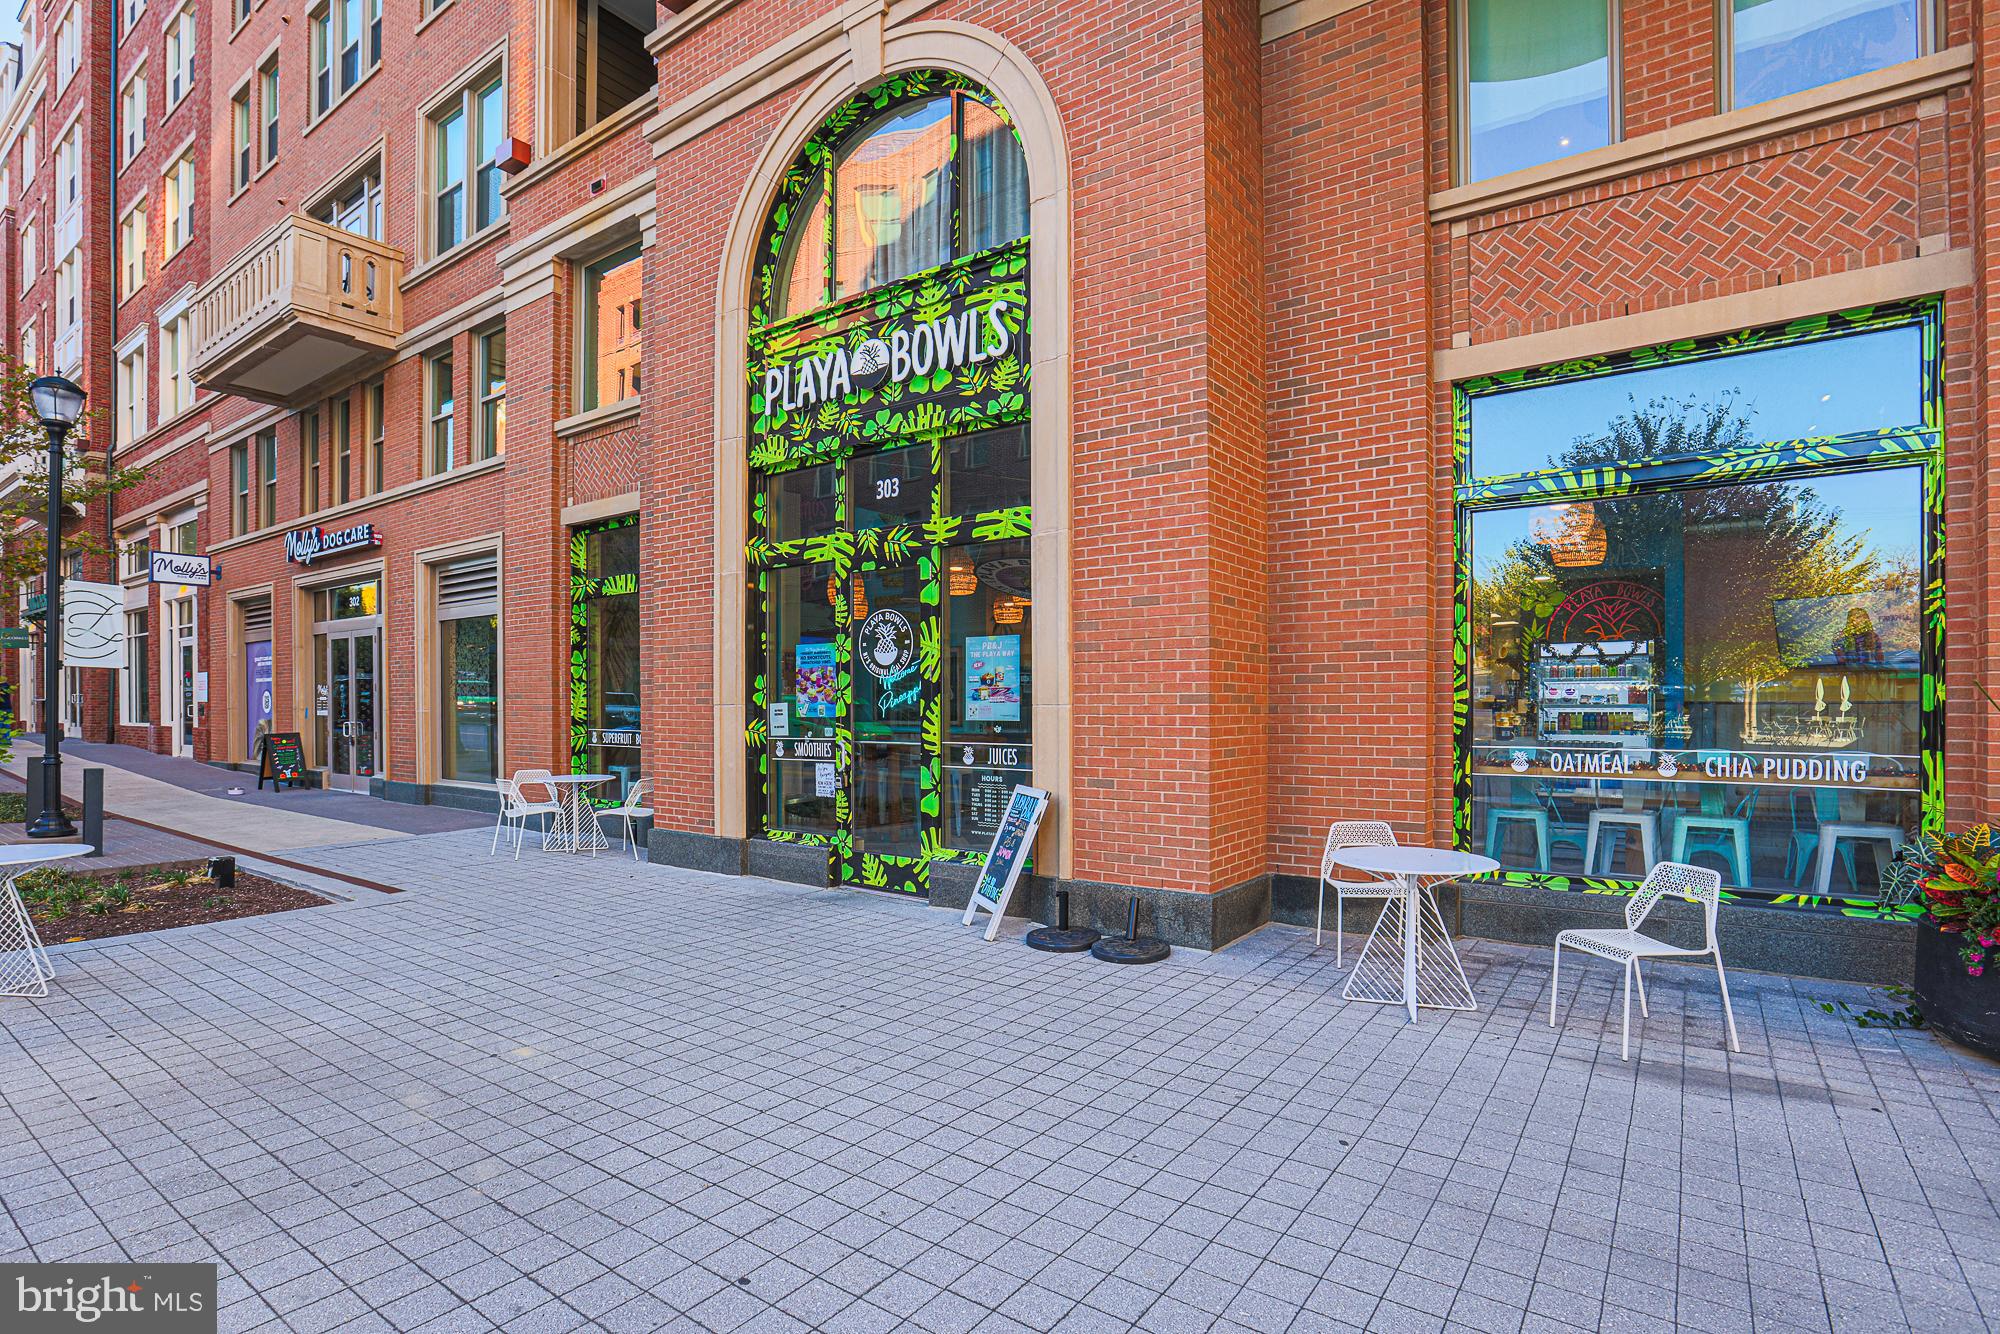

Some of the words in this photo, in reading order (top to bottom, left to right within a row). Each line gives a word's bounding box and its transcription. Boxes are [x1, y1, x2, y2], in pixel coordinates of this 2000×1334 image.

[765, 348, 851, 416] PLAYA
[891, 301, 1008, 383] BOWLS
[876, 477, 900, 500] 303
[284, 526, 320, 565] Molly's
[323, 531, 342, 549] DOG
[344, 523, 369, 543] CARE
[153, 558, 209, 579] Molly's
[349, 595, 360, 607] 302
[1563, 586, 1604, 613] PLAYA
[1616, 583, 1658, 608] BOWLS
[864, 613, 884, 635] PLAYA
[885, 612, 907, 633] BOWLS
[982, 641, 1003, 650] PB&J
[982, 650, 1001, 658] PLAYA
[901, 649, 910, 665] SHOP
[602, 732, 632, 745] SUPERFRUIT
[794, 742, 832, 757] SMOOTHIES
[987, 747, 1018, 766] JUICES
[1550, 752, 1634, 775] OATMEAL
[1705, 756, 1754, 779] CHIA
[1763, 757, 1867, 783] PUDDING
[981, 775, 1003, 783] HOURS
